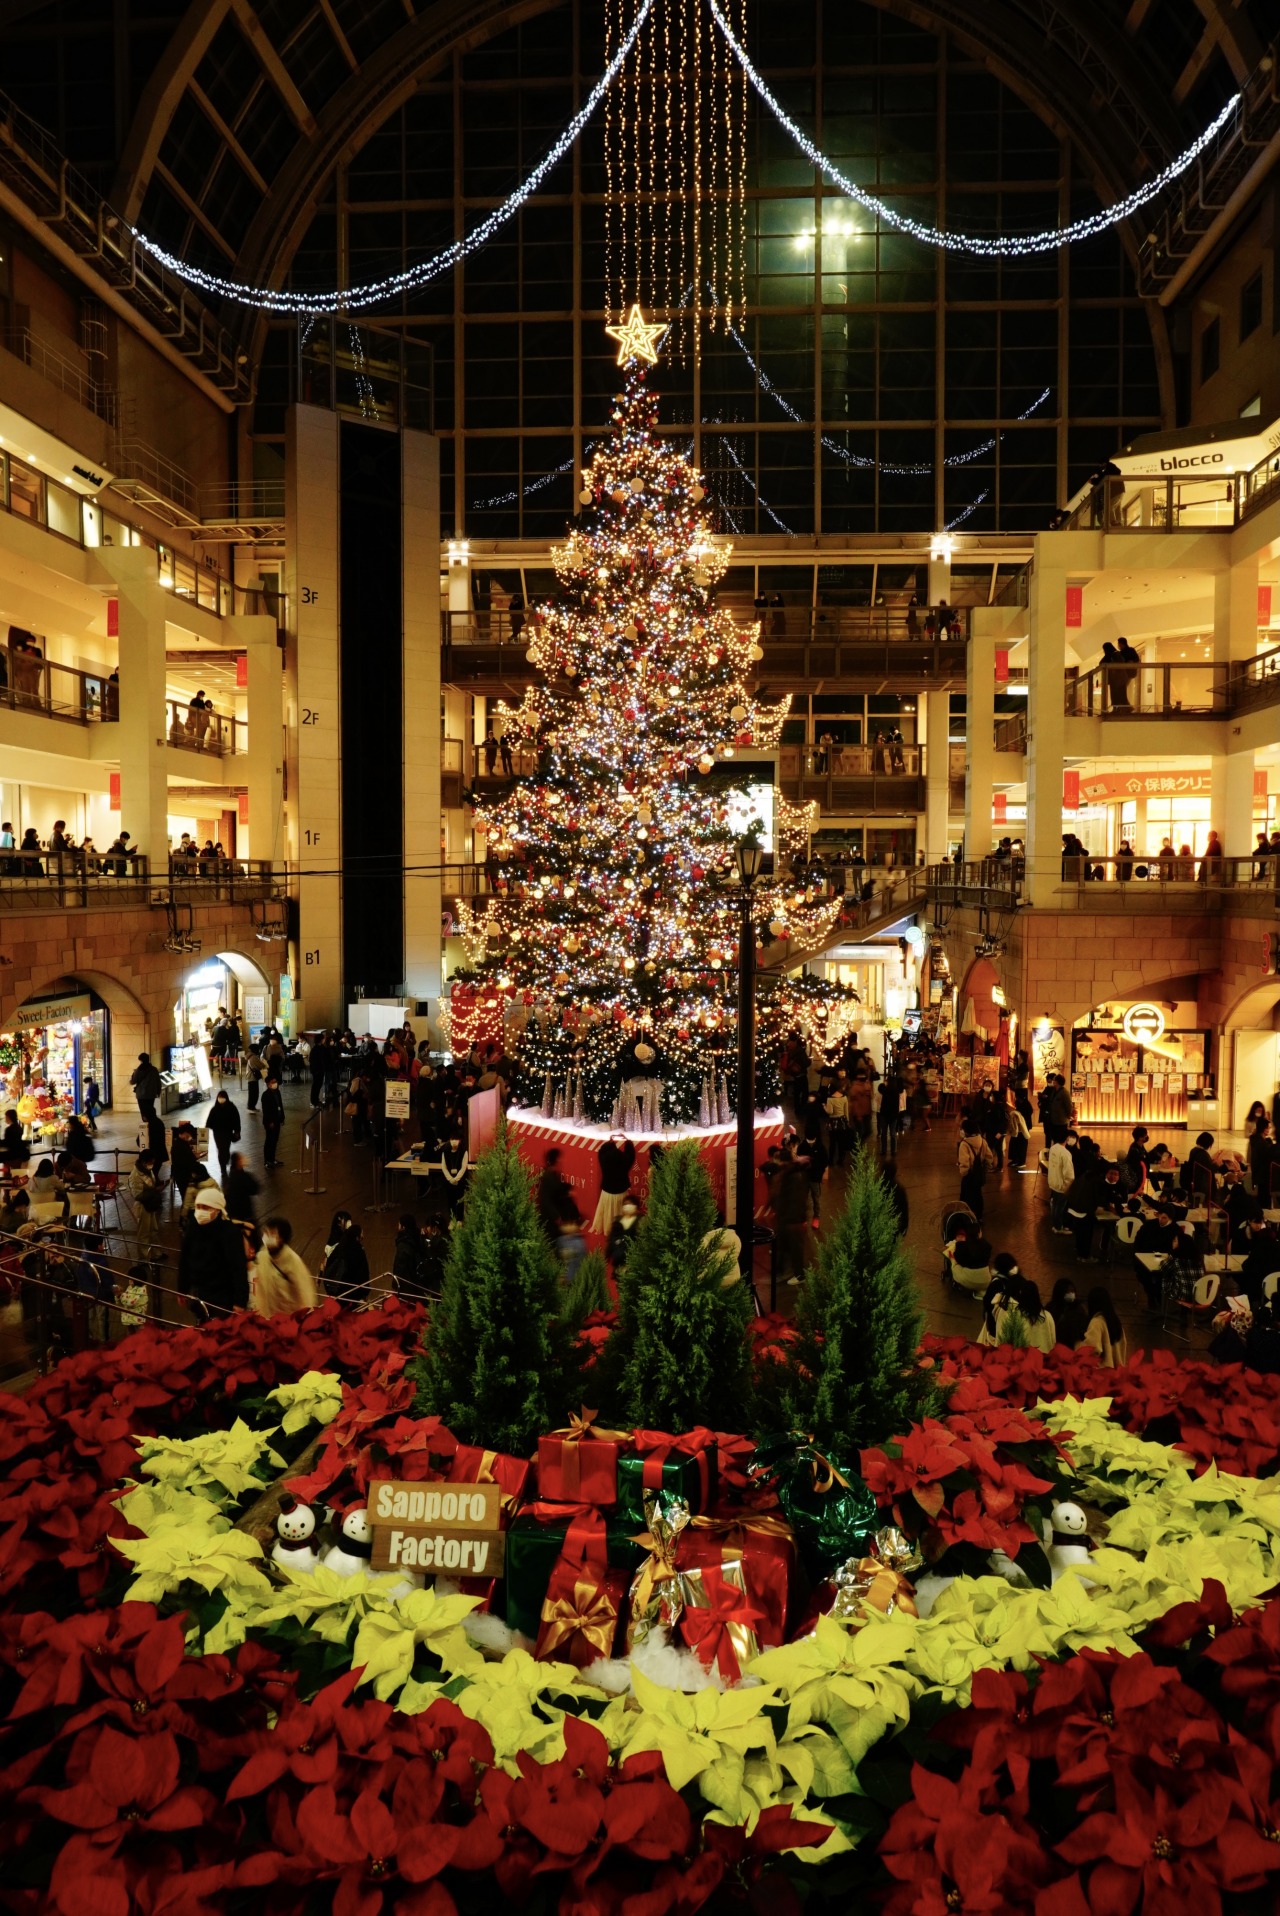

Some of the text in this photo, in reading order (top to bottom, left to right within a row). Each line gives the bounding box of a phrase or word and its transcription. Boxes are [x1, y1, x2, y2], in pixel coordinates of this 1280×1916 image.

[1160, 453, 1224, 472] blocco
[301, 587, 319, 604] 3F
[302, 708, 319, 725] 2F
[304, 830, 320, 846] 1F
[305, 948, 321, 965] B1
[376, 1484, 487, 1523] Sapporo
[389, 1530, 489, 1574] Factory
